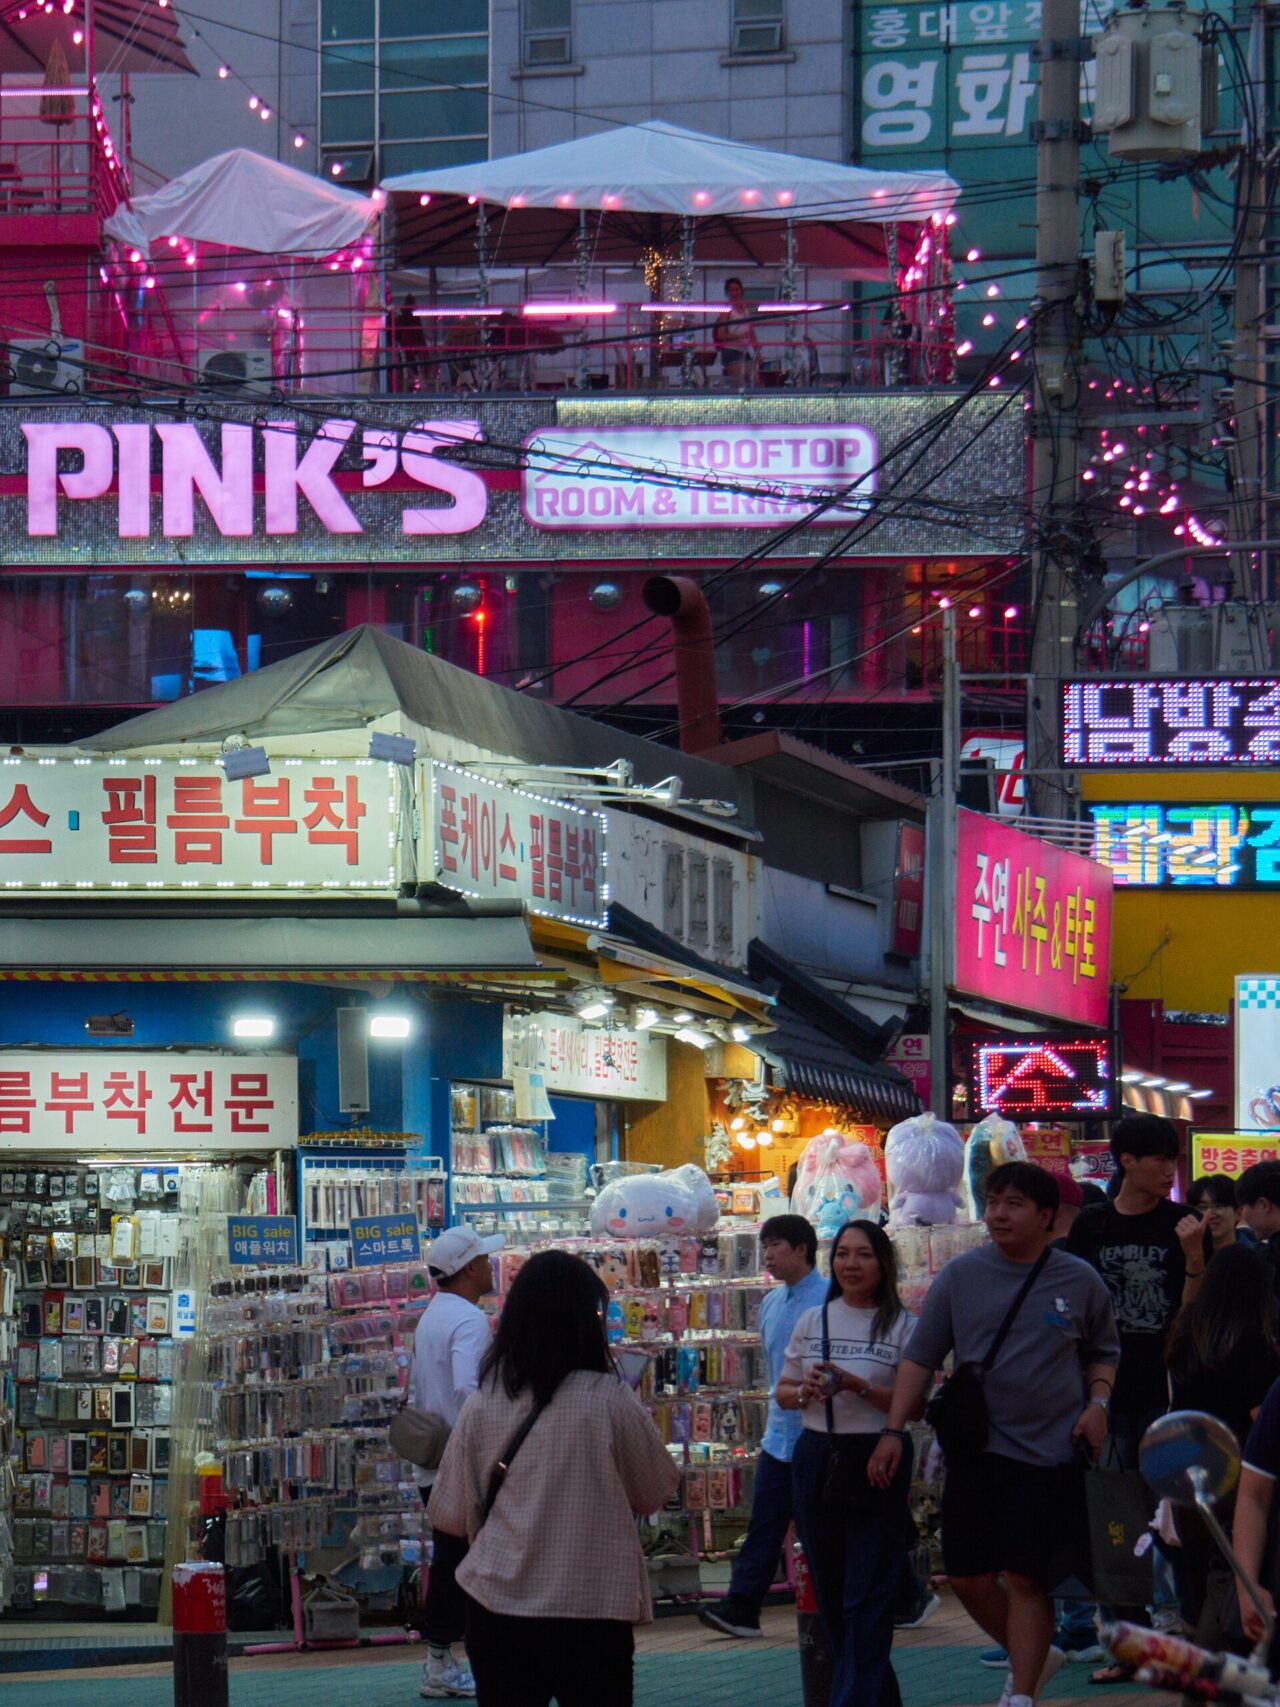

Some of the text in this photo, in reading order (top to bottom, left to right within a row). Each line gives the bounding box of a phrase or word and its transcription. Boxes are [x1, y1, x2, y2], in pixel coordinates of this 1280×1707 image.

[872, 5, 1040, 48] 홍대앞
[861, 52, 1038, 147] 영화
[679, 438, 862, 469] ROOFTOP
[20, 420, 487, 537] PINK'S
[534, 487, 645, 517] ROOM
[651, 487, 677, 517] &
[232, 1223, 291, 1240] BIG sale
[355, 1222, 415, 1241] BIG sale
[234, 1240, 290, 1256] 애플워치
